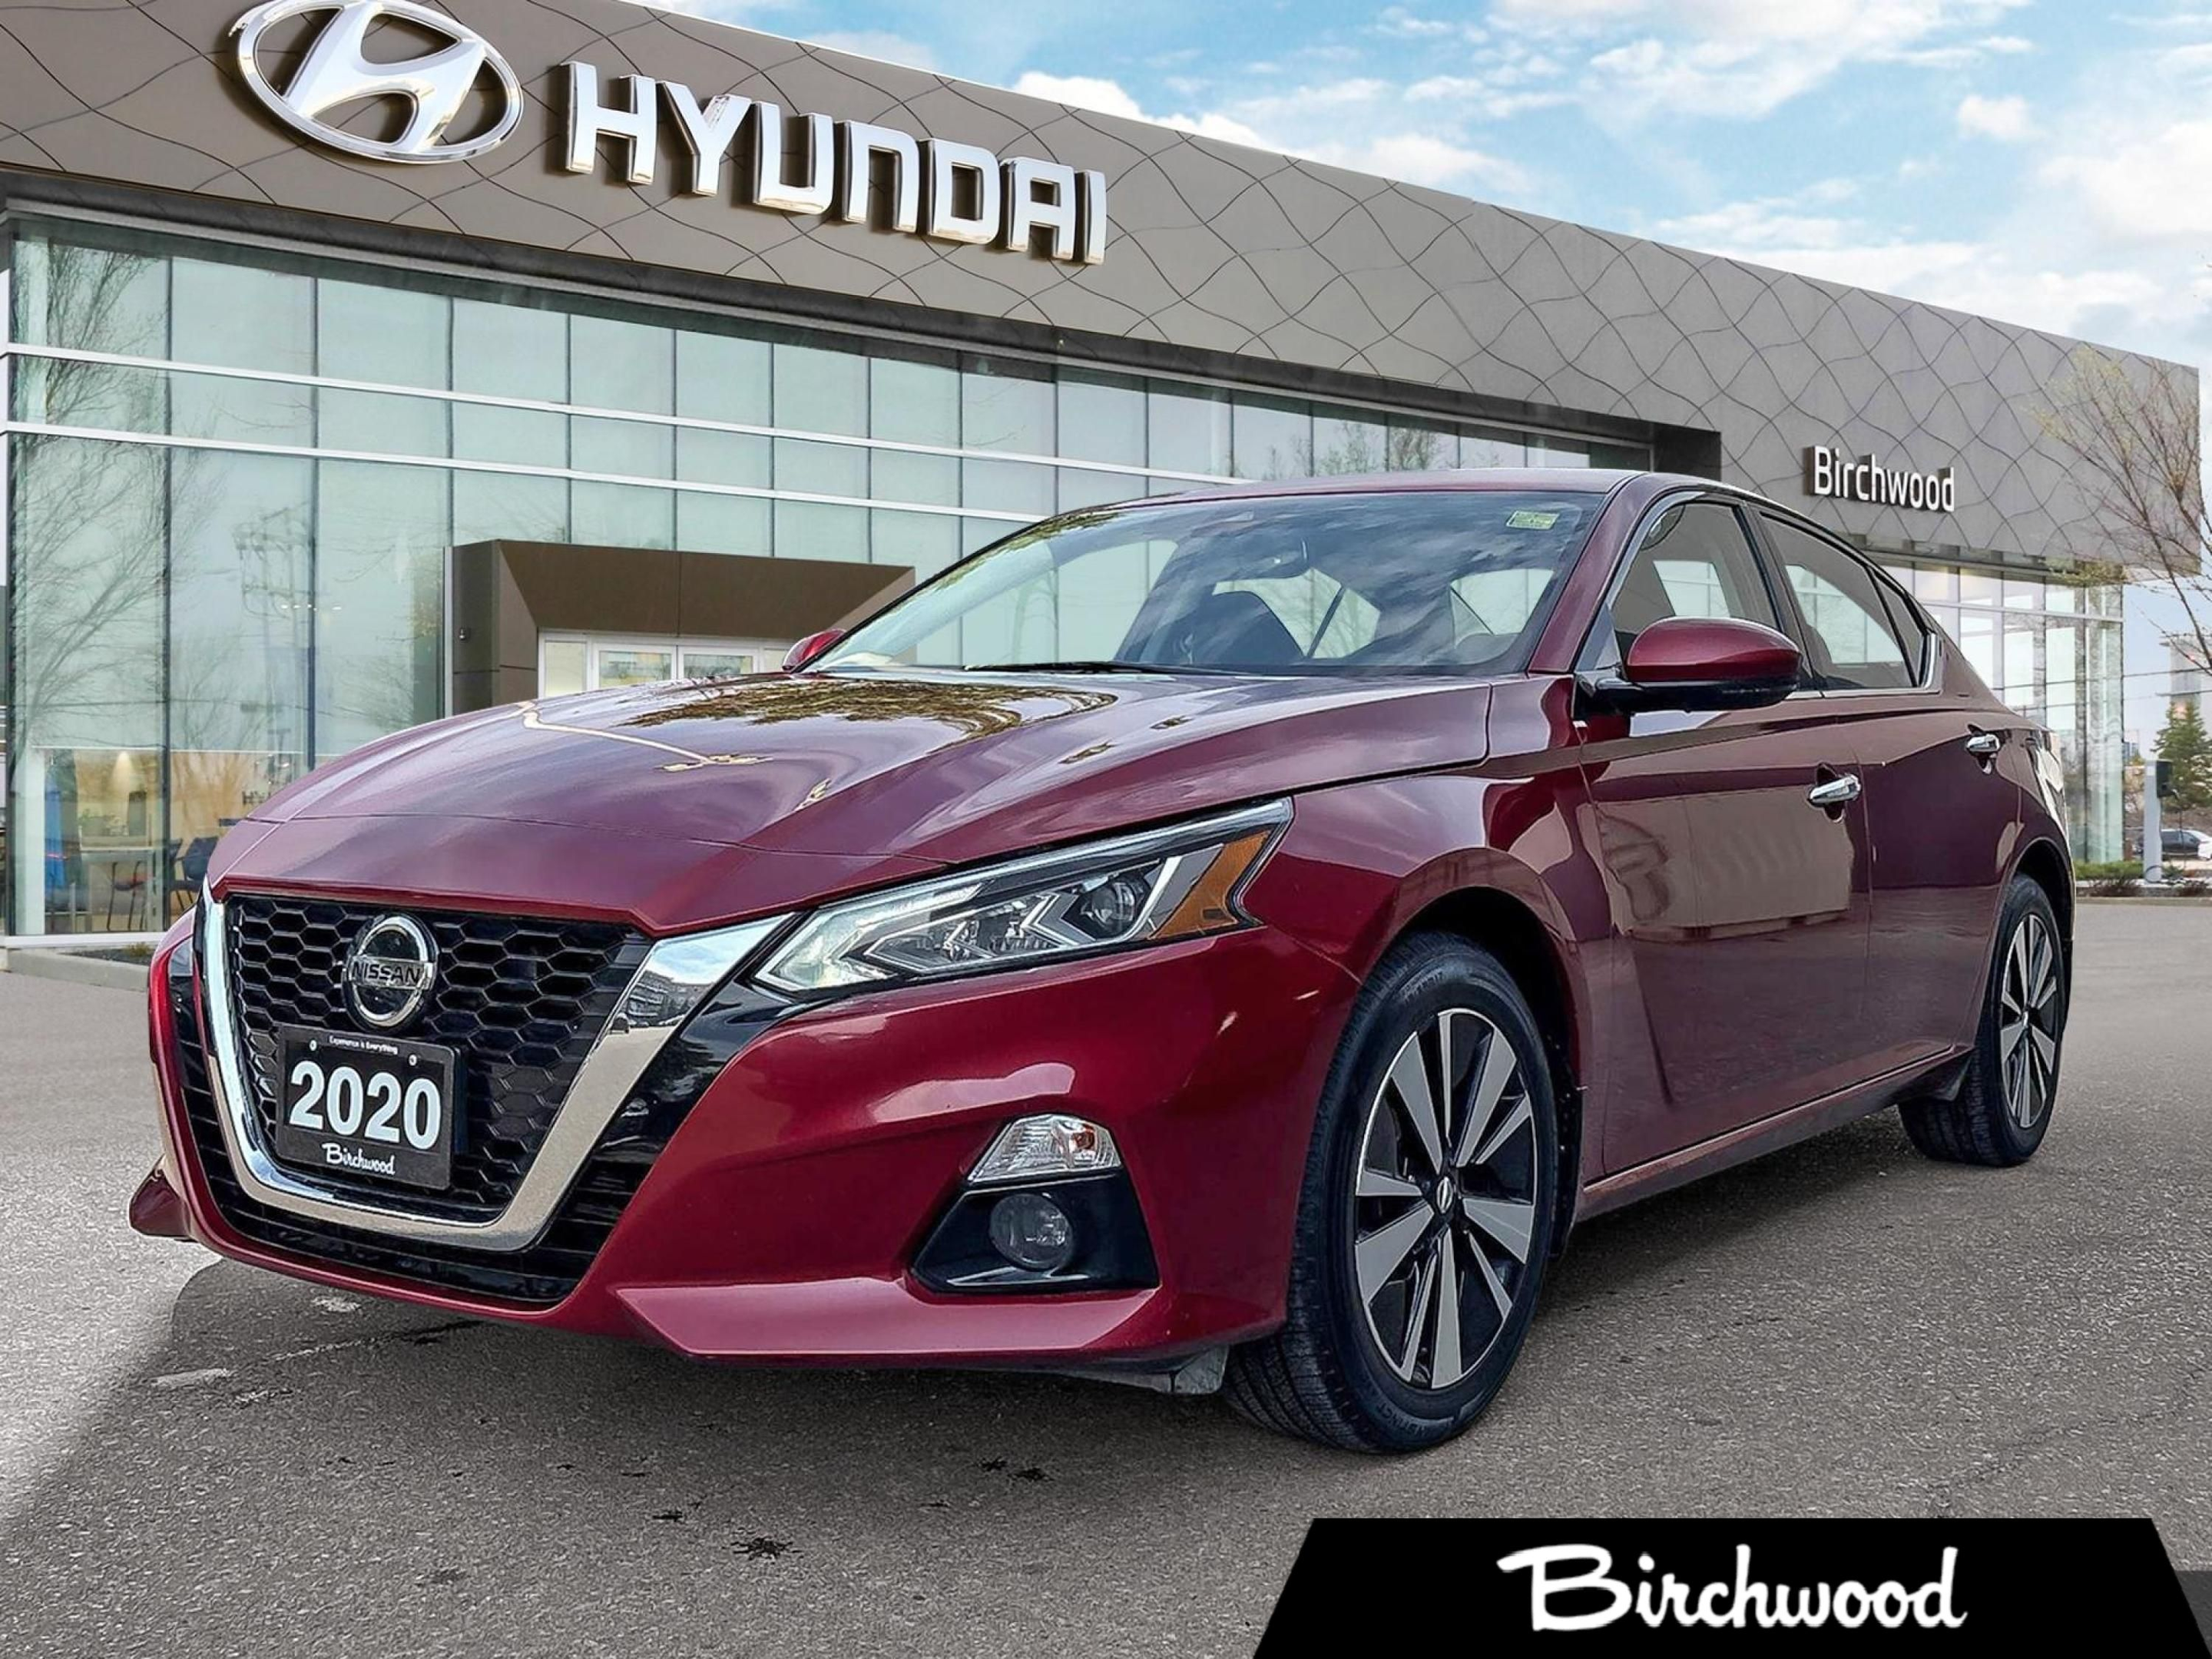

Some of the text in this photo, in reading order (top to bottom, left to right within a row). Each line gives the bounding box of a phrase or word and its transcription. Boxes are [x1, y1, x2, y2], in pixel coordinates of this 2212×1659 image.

[561, 61, 1108, 266] HYUNDAI
[1812, 445, 1955, 512] Birchwood
[353, 961, 421, 983] NISSAN
[290, 1061, 441, 1150] 2020
[322, 1143, 396, 1175] Birchwood
